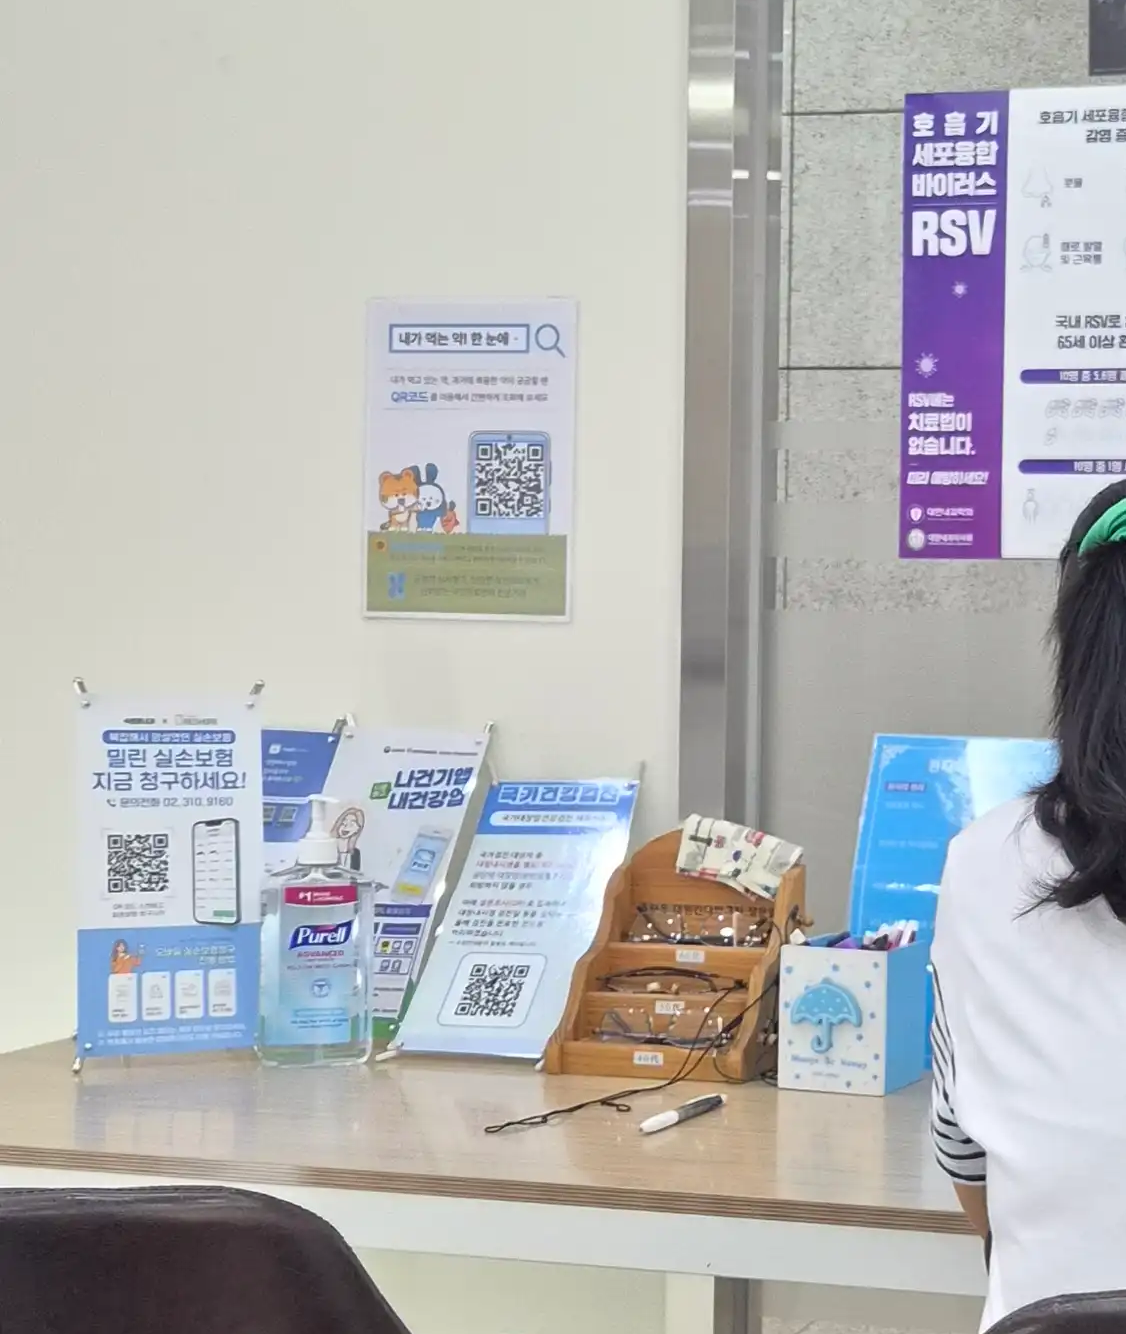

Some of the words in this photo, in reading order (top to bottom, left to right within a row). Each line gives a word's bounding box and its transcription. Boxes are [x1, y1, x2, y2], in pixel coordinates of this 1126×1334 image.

[1039, 110, 1078, 124] 호흡기
[1086, 129, 1111, 143] 감염
[912, 140, 999, 167] 세포융합
[912, 171, 996, 197] 바이러스
[912, 209, 996, 256] RSV
[1056, 315, 1081, 329] 국내
[1085, 315, 1120, 328] RSV로
[399, 332, 422, 346] 내가
[425, 332, 449, 346] 먹는
[471, 332, 482, 345] 한
[486, 332, 509, 346] 눈에
[1057, 335, 1085, 349] 65세
[1089, 335, 1115, 349] 이상
[908, 412, 972, 431] 치료법이
[908, 436, 976, 455] 없습니다.
[107, 749, 146, 768] 밀린
[153, 748, 233, 768] 실손보험
[92, 772, 133, 791] 지금
[140, 771, 246, 791] 청구하세요!
[297, 927, 348, 944] Purell
